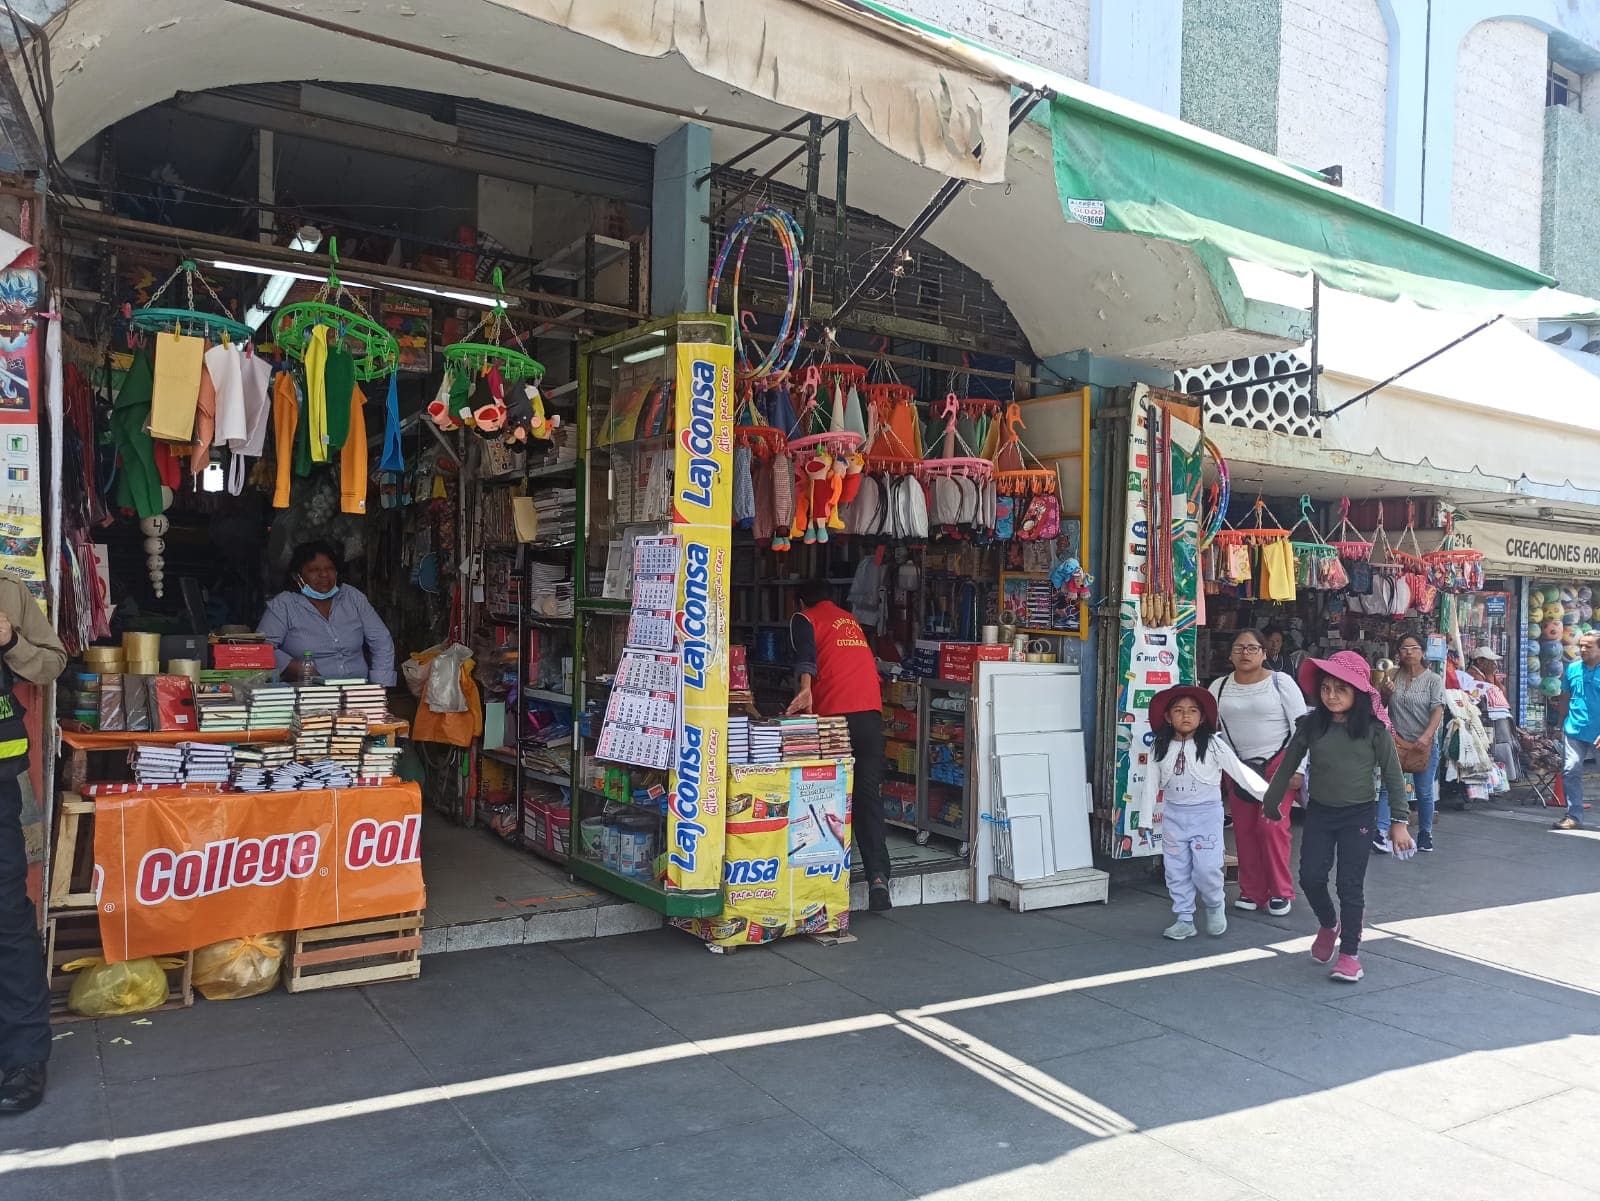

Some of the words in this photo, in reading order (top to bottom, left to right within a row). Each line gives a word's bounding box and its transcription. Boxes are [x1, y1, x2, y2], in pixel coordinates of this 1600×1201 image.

[721, 365, 731, 394] crear
[720, 394, 733, 422] para
[681, 360, 721, 509] Layconsa
[1505, 538, 1581, 563] CREACIONES
[1583, 546, 1600, 564] AR
[676, 541, 713, 691] Layconsa
[615, 724, 636, 732] MARZO
[707, 728, 720, 757] crear
[706, 757, 721, 785] para
[669, 723, 706, 873] Layconsa
[344, 814, 421, 871] Col
[136, 830, 320, 905] College
[730, 890, 753, 905] para
[755, 888, 777, 899] crear
